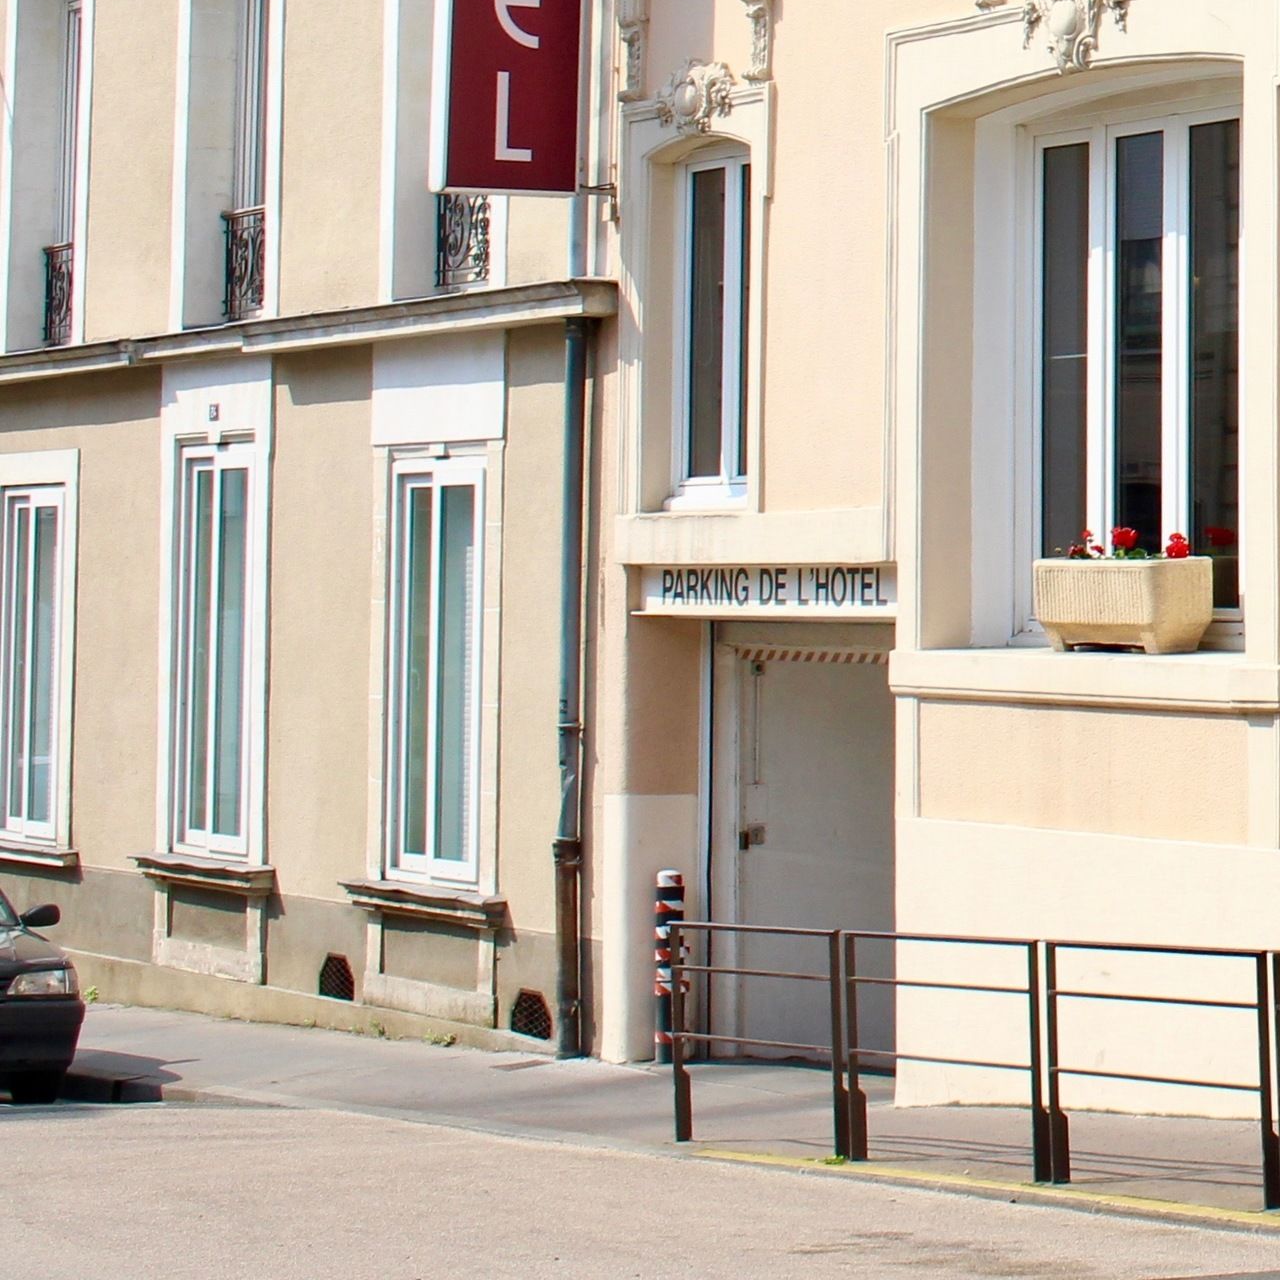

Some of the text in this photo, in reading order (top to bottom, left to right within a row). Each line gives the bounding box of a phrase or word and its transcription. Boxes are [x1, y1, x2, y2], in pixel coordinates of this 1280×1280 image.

[661, 566, 889, 608] PARKING DE L'HOTEL
